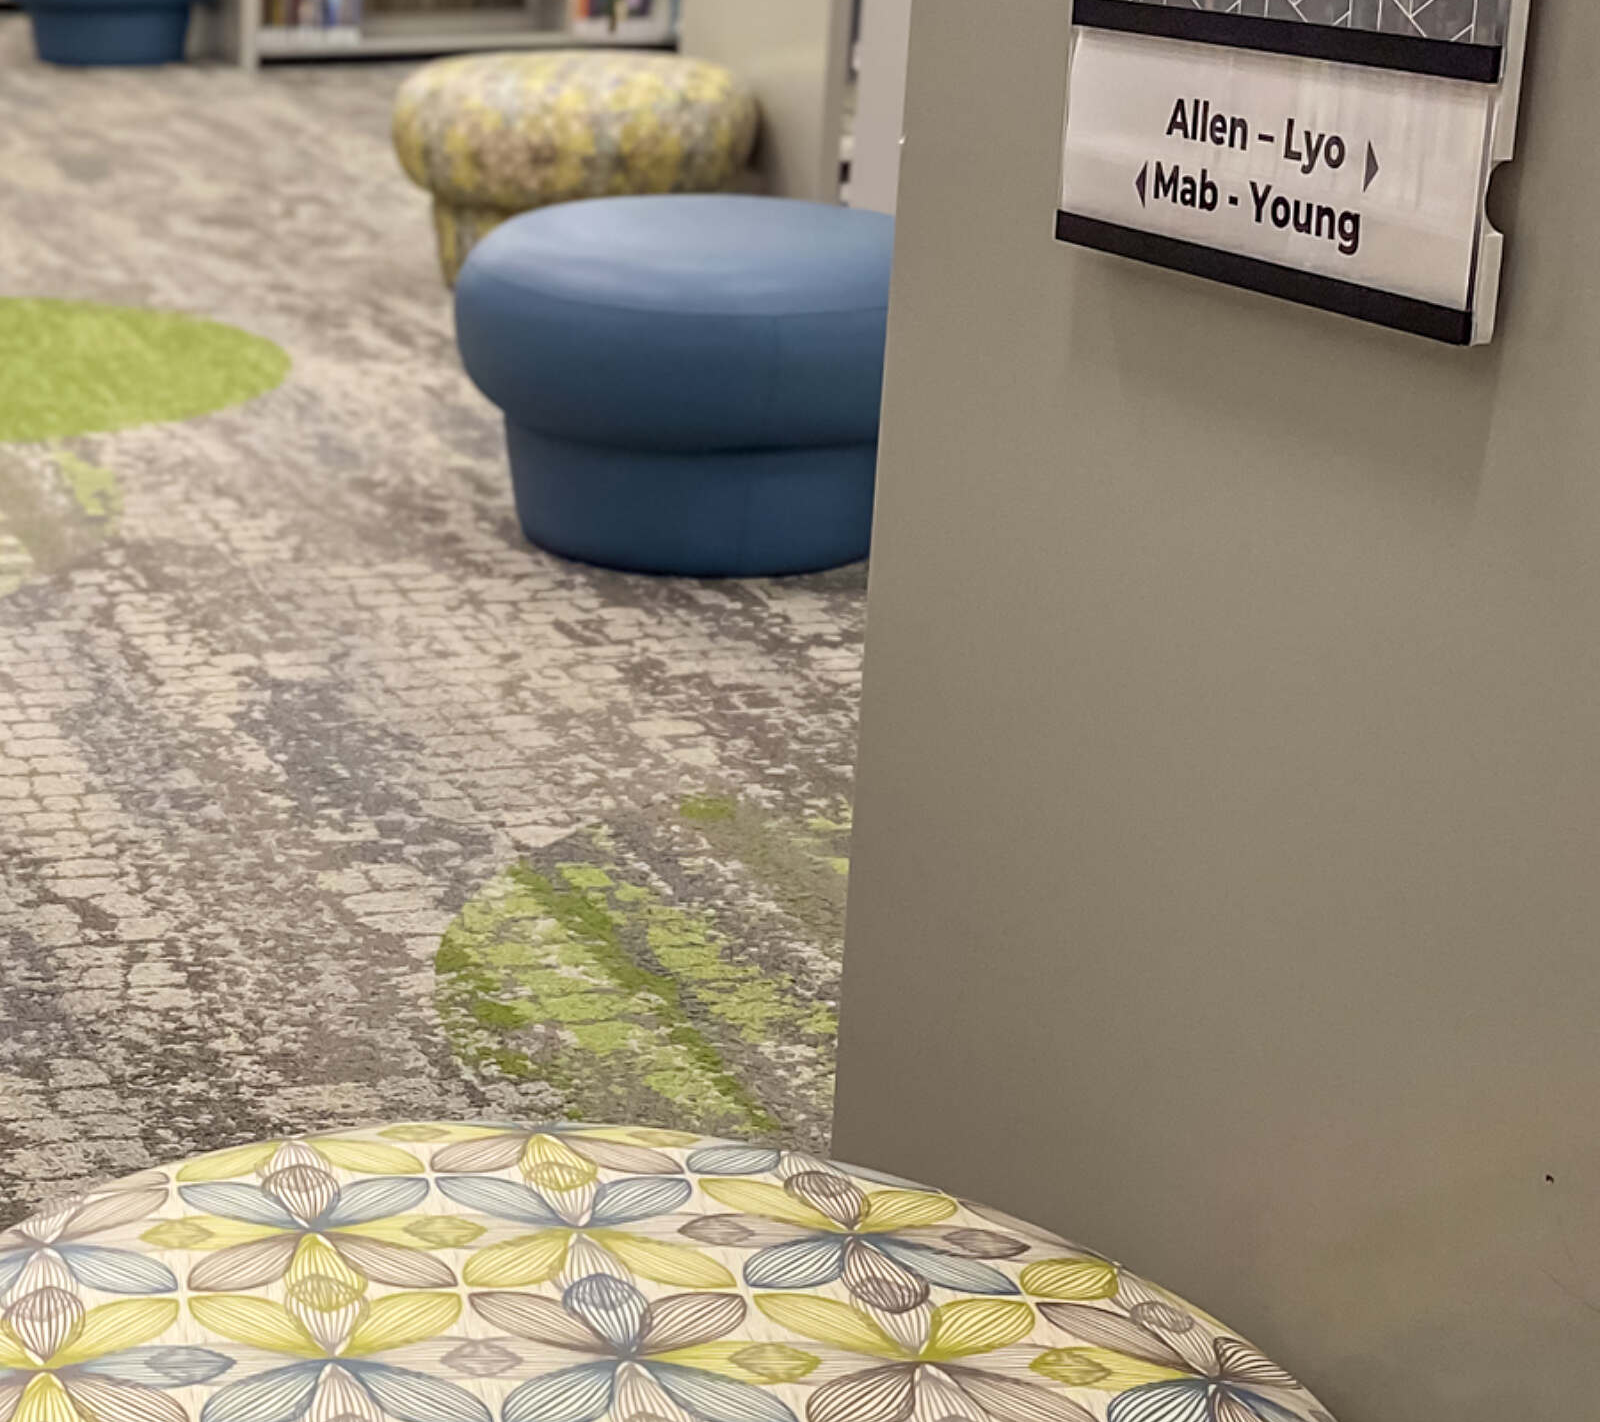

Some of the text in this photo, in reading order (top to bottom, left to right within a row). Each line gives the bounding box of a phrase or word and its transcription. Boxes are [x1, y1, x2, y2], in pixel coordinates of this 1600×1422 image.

[1165, 98, 1248, 150] Allen
[1283, 118, 1345, 174] Lyo
[1153, 161, 1218, 211] Mab
[1249, 180, 1360, 255] Young
